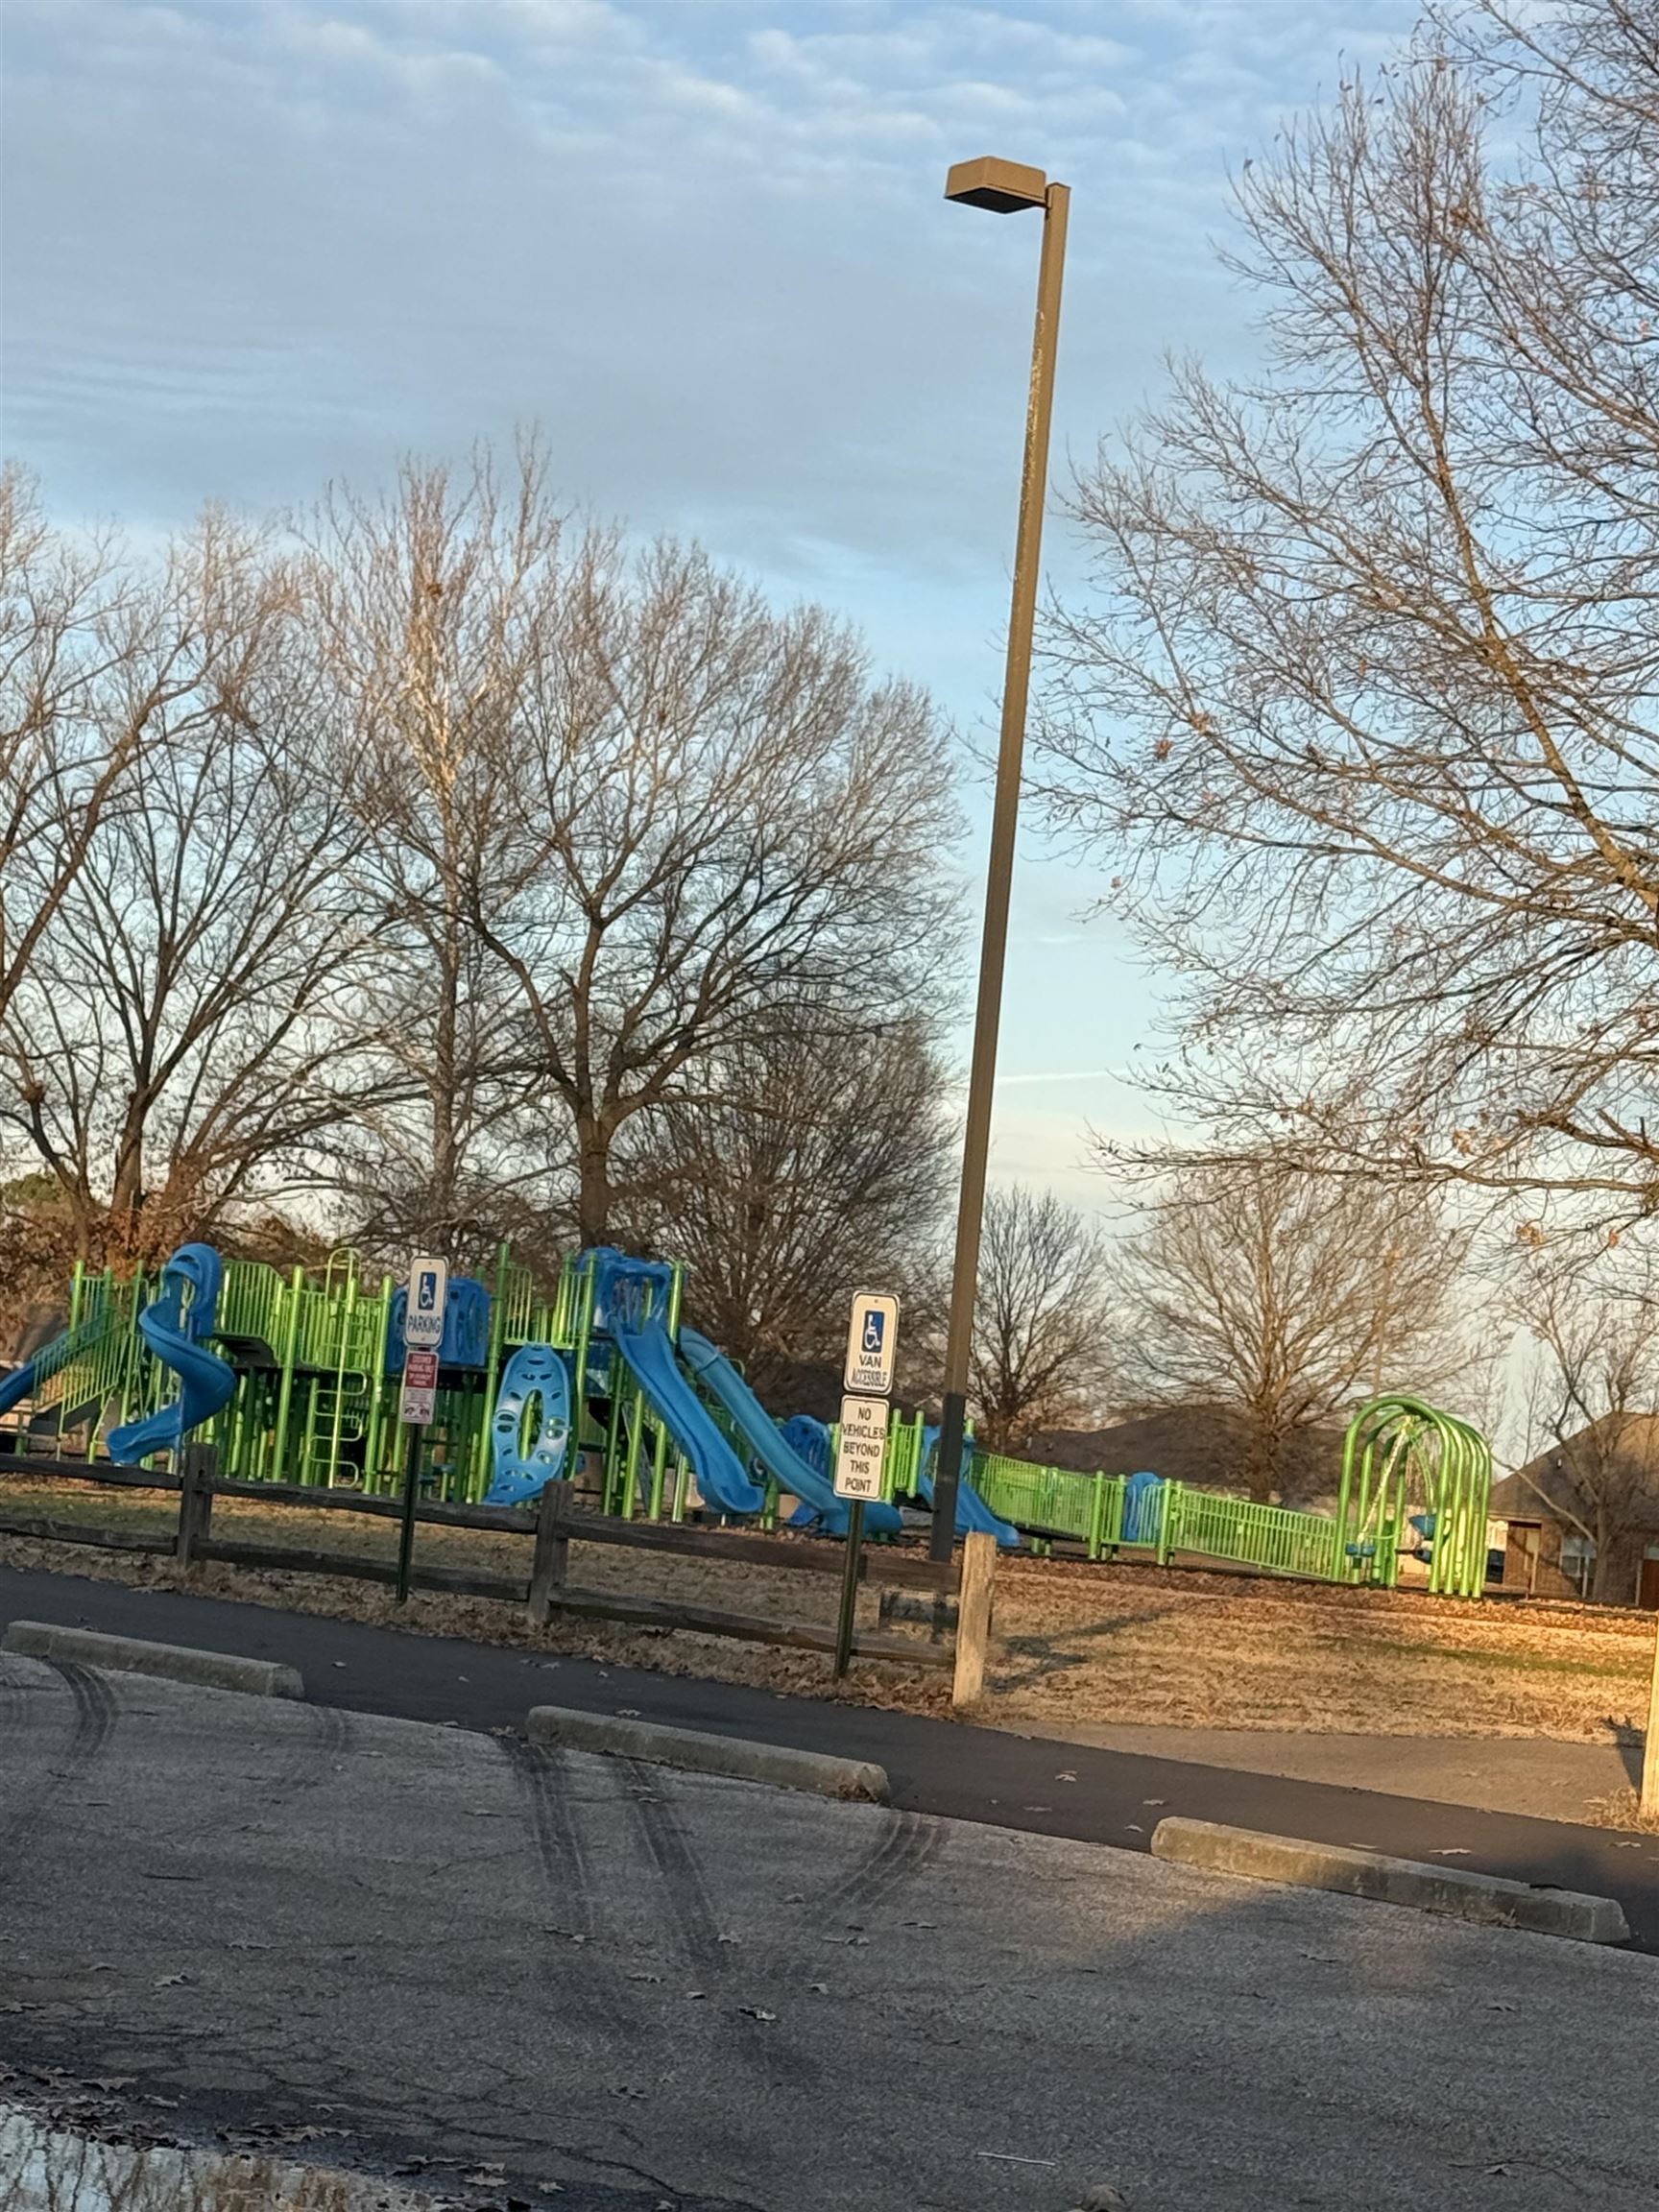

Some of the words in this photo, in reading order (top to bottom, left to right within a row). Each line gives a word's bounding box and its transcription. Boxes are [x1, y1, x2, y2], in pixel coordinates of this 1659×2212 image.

[408, 1314, 441, 1334] PARKING
[859, 1355, 881, 1368] VAN
[857, 1407, 872, 1421] NO
[842, 1423, 885, 1440] VEHICLES
[843, 1442, 880, 1457] BEYOND
[850, 1460, 870, 1474] THIS
[845, 1477, 872, 1493] POINT
